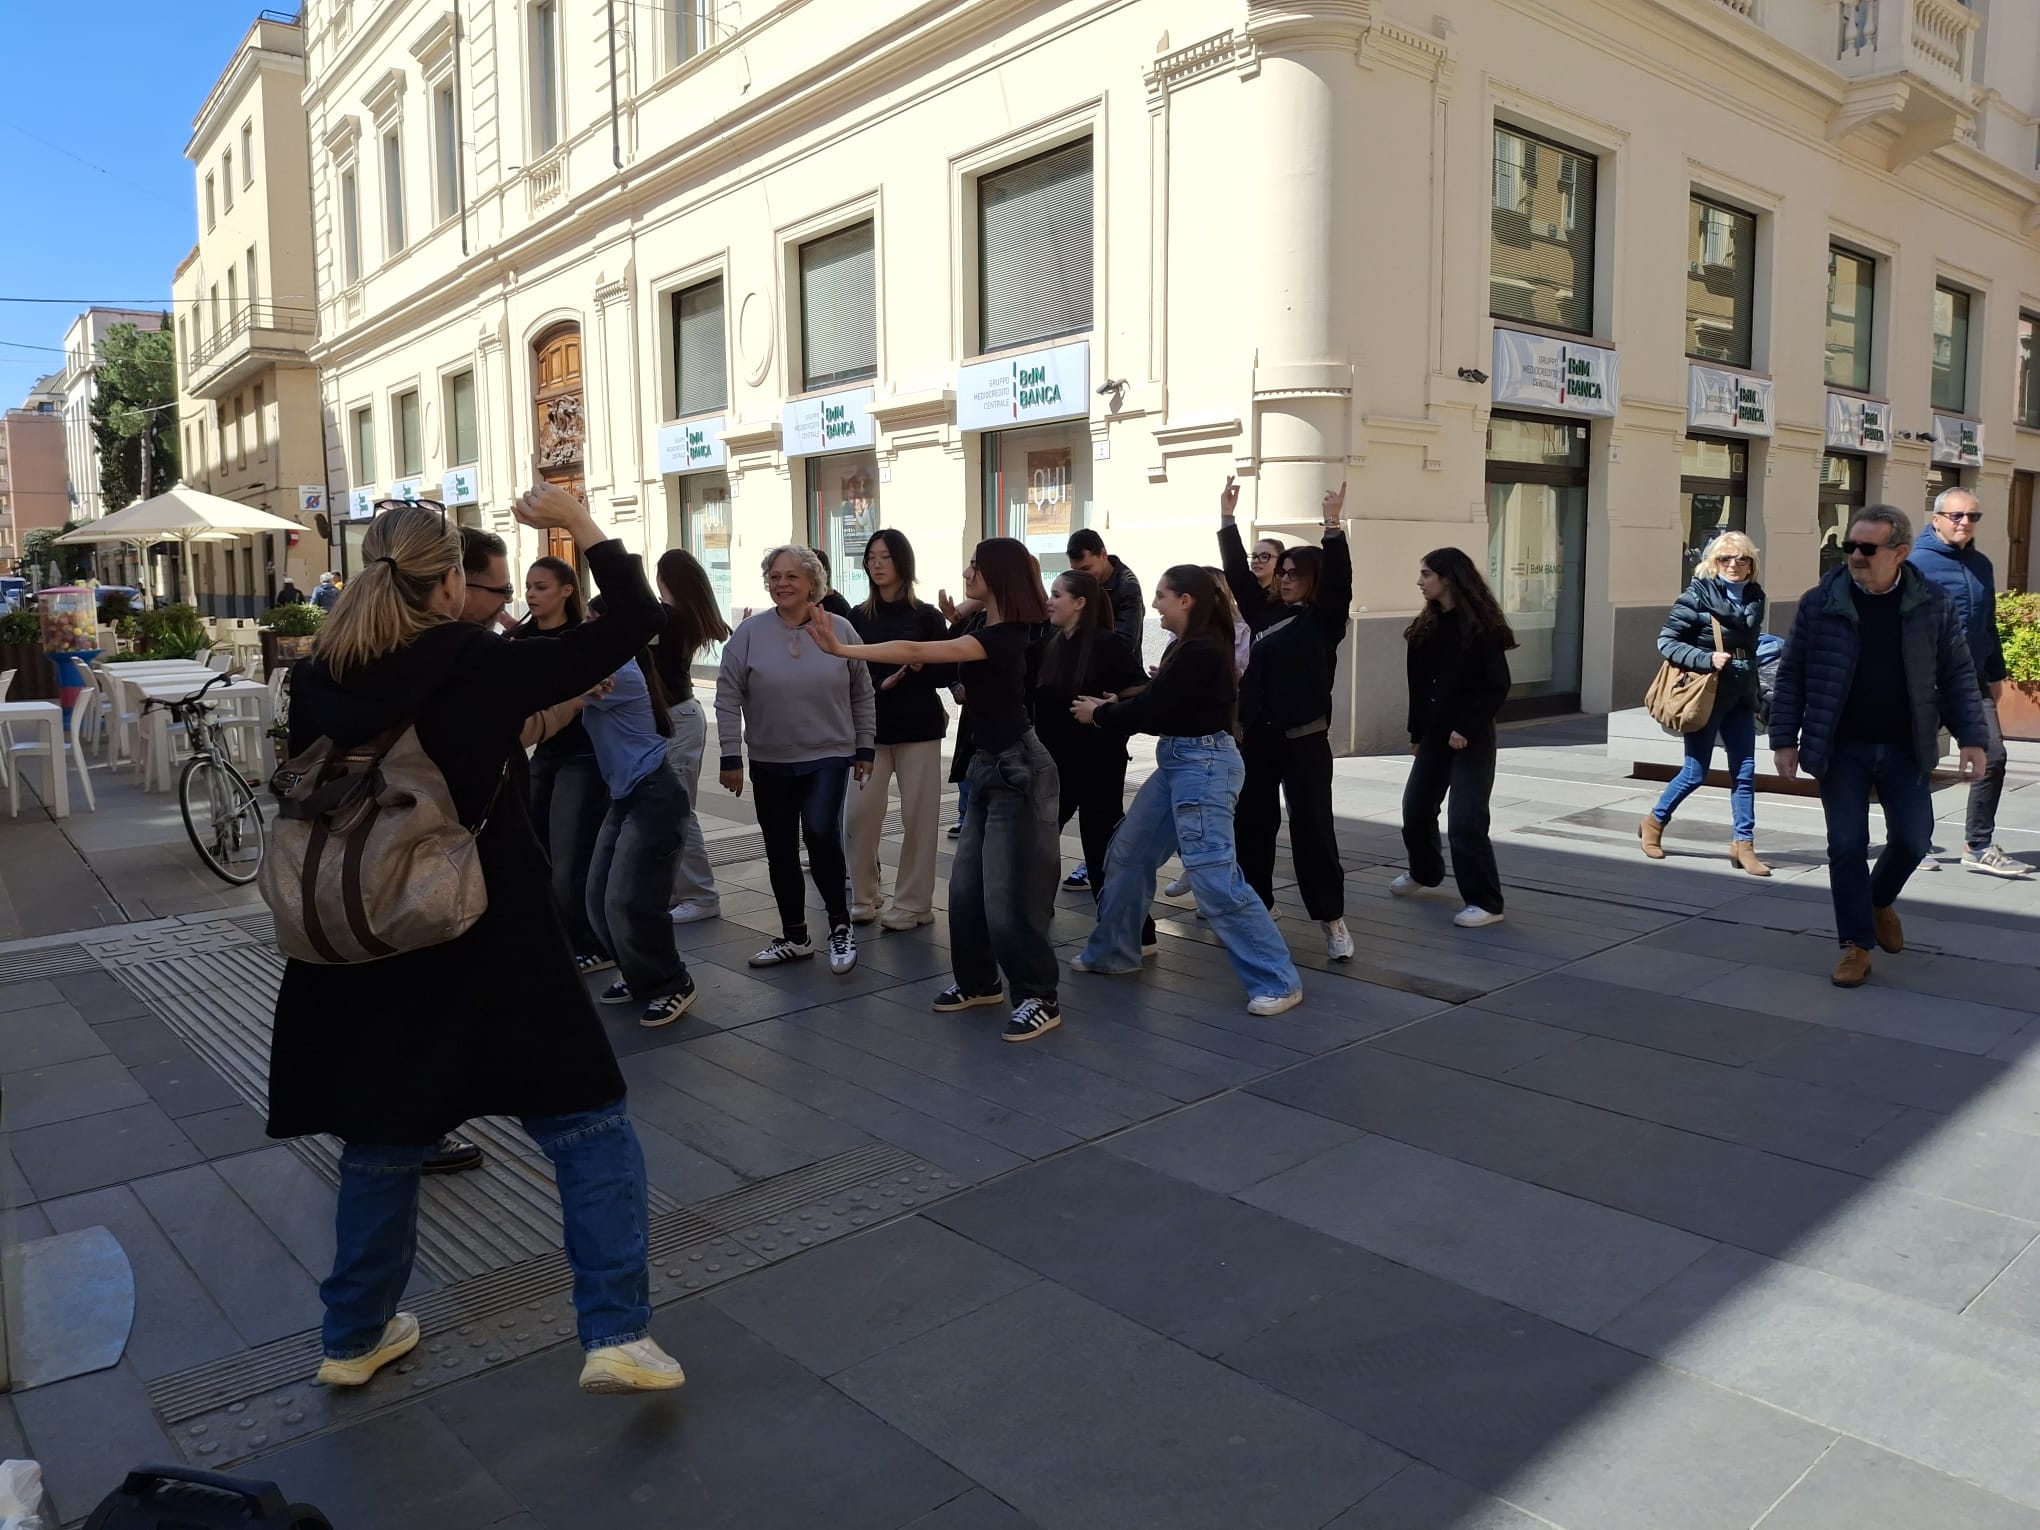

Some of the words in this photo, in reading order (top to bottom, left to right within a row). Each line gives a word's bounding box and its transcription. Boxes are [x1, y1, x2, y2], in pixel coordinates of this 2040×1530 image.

[1567, 357, 1590, 378] BdM
[988, 376, 1010, 388] GRUPPO
[1020, 366, 1046, 388] BdM
[1532, 377, 1557, 390] CENTRALE
[973, 387, 1010, 401] MEDIOCREDITO
[1020, 384, 1062, 410] BANCA
[1567, 378, 1602, 399] BANCA
[983, 398, 1010, 410] CENTRALE
[1739, 405, 1765, 422] BANCA
[826, 420, 856, 440] BANCA
[1033, 465, 1066, 511] QUI
[1530, 564, 1544, 575] BdM
